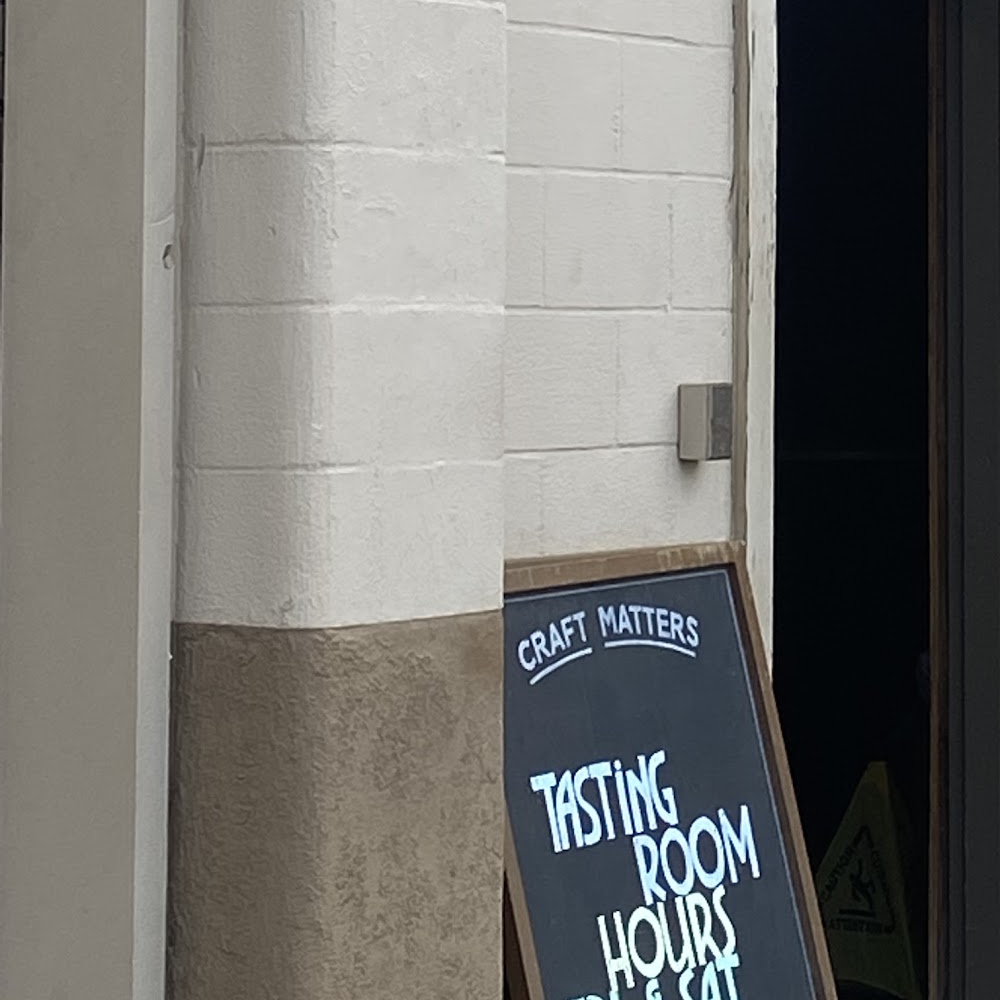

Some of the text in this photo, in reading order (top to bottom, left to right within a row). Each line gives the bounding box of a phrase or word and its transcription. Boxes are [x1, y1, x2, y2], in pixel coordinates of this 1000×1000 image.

[517, 603, 699, 672] CRAFT MATTERS
[632, 804, 760, 906] ROOM
[597, 884, 736, 992] HOURS
